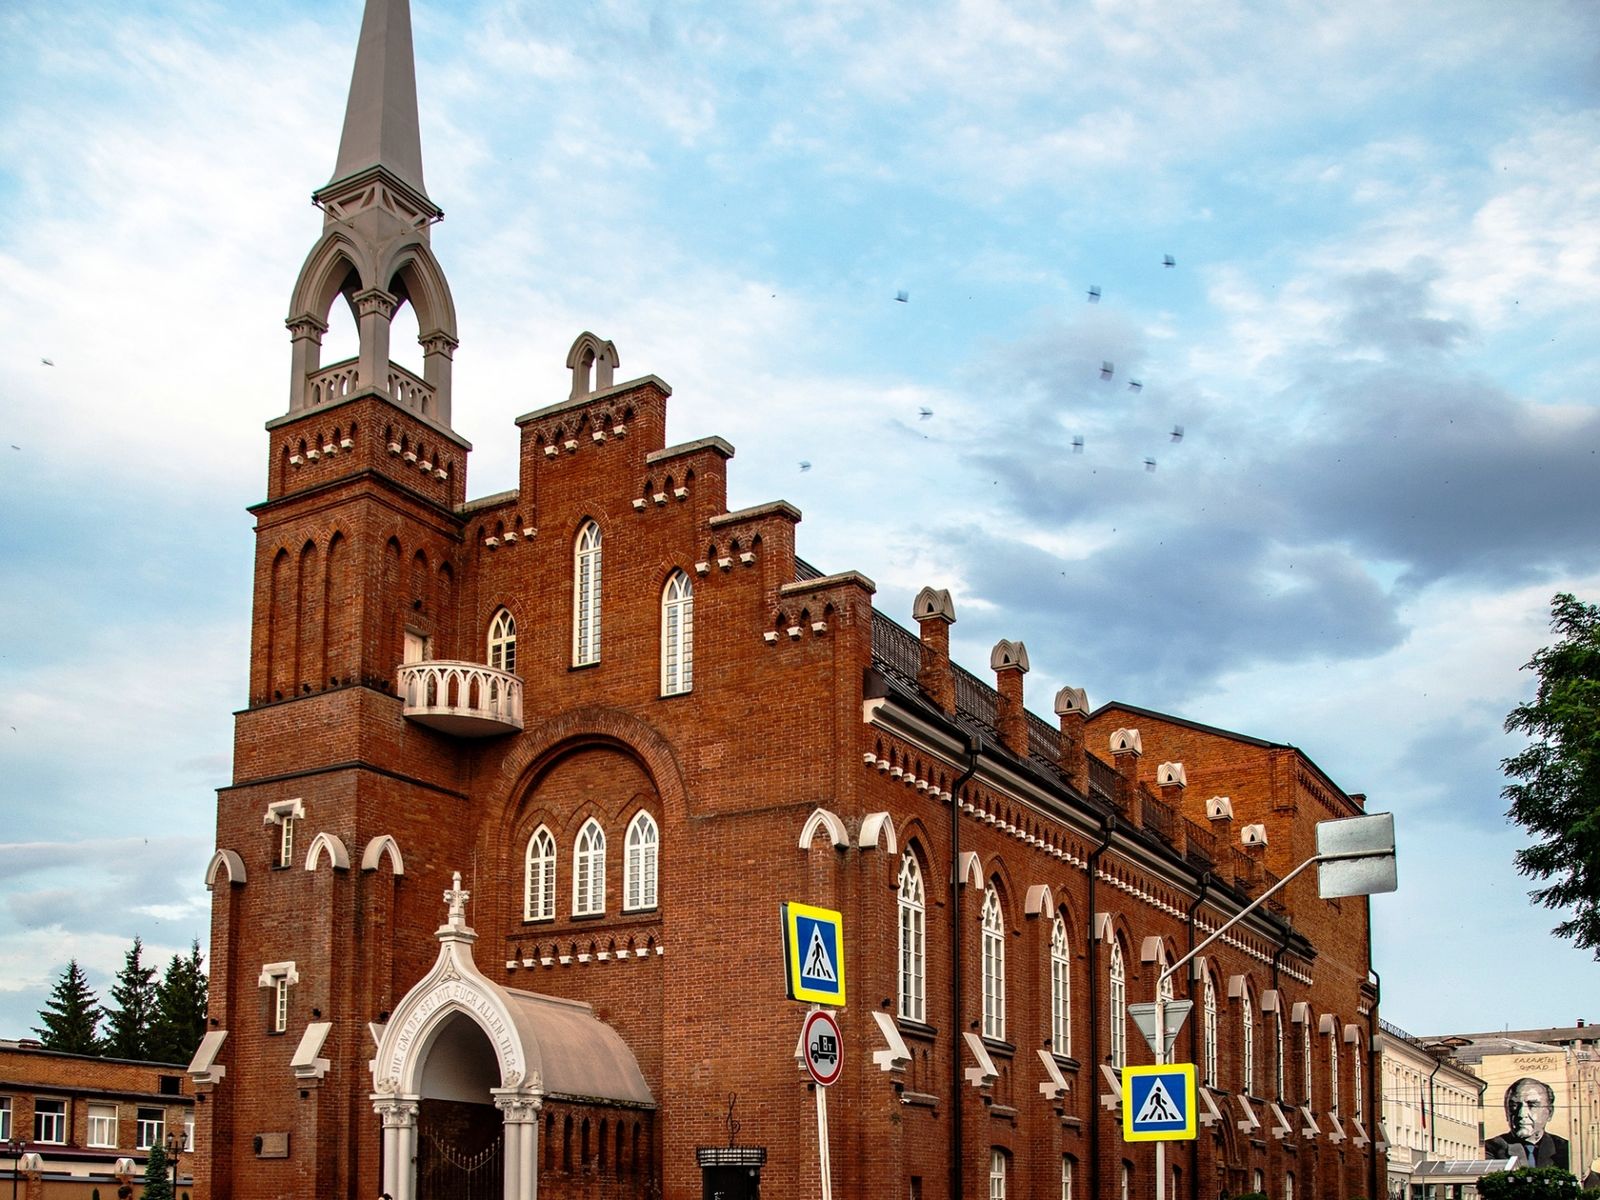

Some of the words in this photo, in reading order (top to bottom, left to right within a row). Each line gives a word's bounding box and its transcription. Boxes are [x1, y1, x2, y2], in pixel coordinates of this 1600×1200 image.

[434, 985, 452, 1003] MIT
[455, 984, 479, 1007] EUCH
[420, 996, 435, 1016] SEI
[477, 1001, 505, 1039] ALLEN.
[397, 1012, 422, 1052] GNADE
[391, 1053, 404, 1073] DIE
